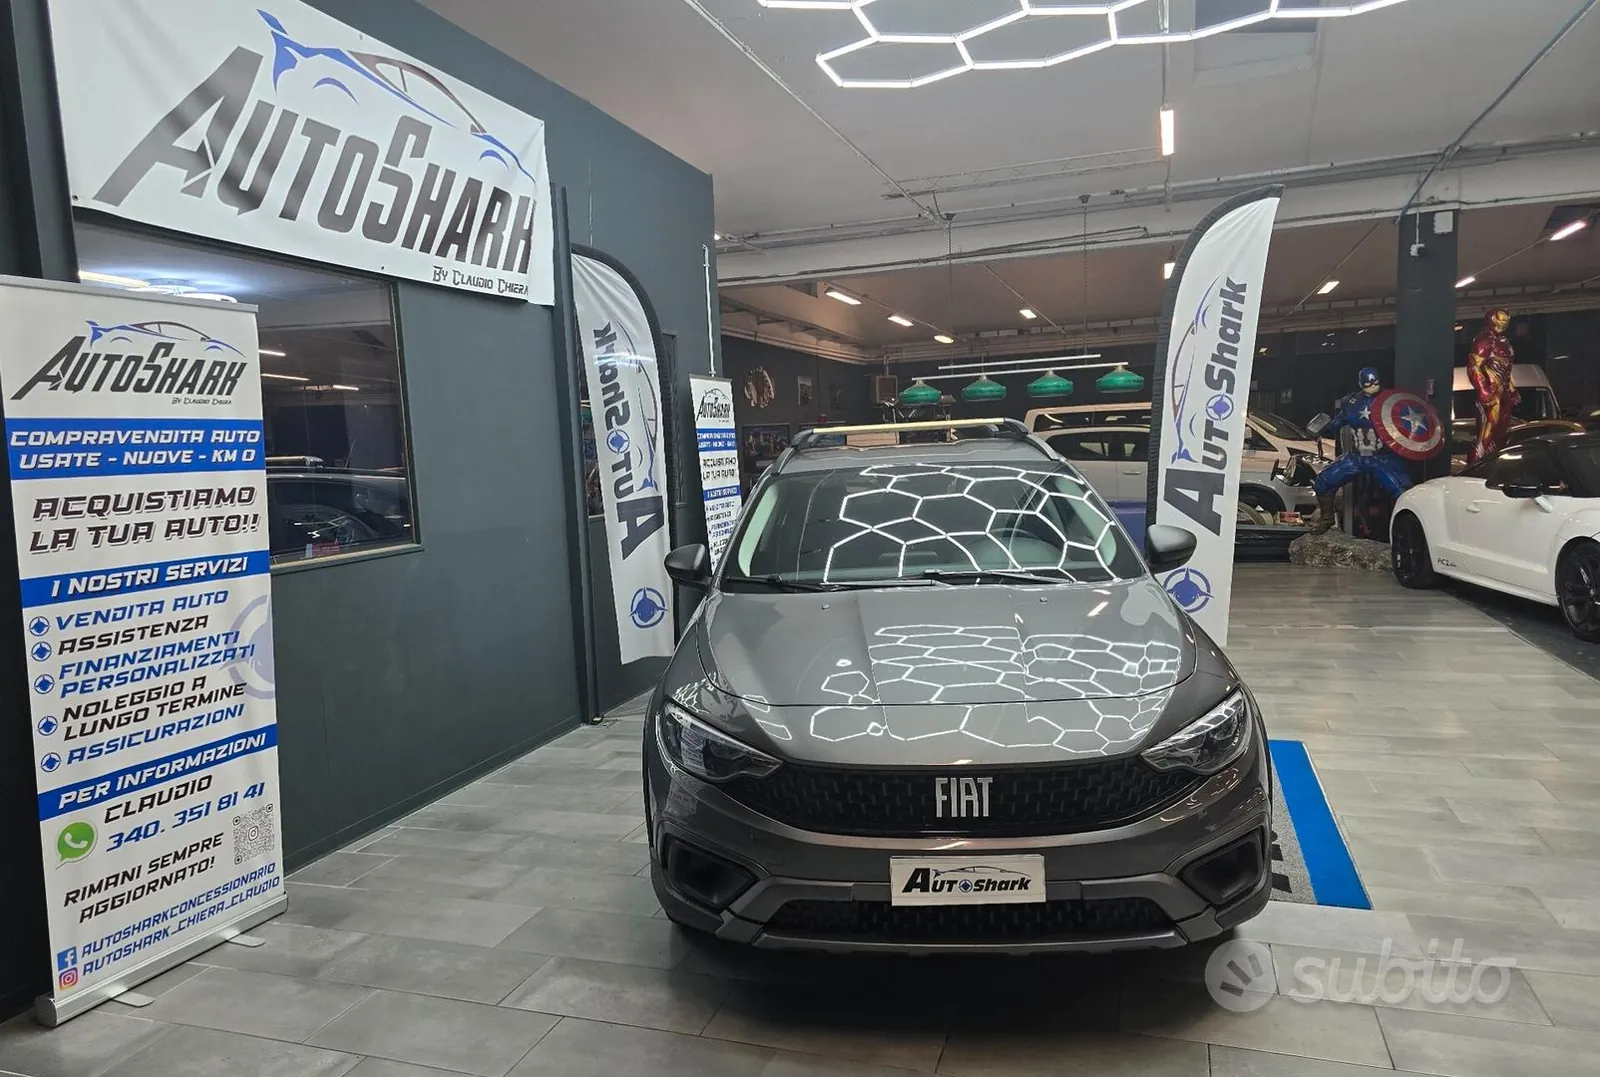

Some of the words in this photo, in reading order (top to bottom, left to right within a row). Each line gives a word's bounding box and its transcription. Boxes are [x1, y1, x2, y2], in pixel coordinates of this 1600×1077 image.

[10, 430, 204, 446] COMPRAVENDITA
[211, 430, 260, 444] AUTO
[19, 452, 102, 469] USATE
[123, 450, 194, 465] NUOVE
[212, 450, 236, 462] KM
[33, 486, 256, 519] ACQUISTIAMO
[30, 528, 77, 553] LA
[87, 521, 155, 547] TUA
[164, 513, 260, 538] AUTO!!
[51, 580, 60, 597] I
[68, 567, 158, 595] NOSTRI
[165, 557, 249, 581] SERVIZI
[56, 600, 164, 631] VENDITA
[172, 590, 229, 611] AUTO
[58, 615, 209, 655] ASSISTENZA
[59, 631, 241, 680] FINANZIAMENTI
[60, 644, 256, 699] PERSONALIZZATI
[62, 681, 184, 722] NOLEGGIO
[191, 675, 207, 691] A
[64, 708, 149, 742] LUNGO
[156, 682, 247, 718] TERMINE
[67, 704, 245, 765] ASSICURAZIONI
[58, 782, 111, 810] PER
[115, 732, 267, 790] INFORMAZIONI
[104, 774, 213, 824] CLAUDIO
[106, 820, 165, 852] 340.
[171, 801, 211, 829] 351
[216, 791, 238, 812] 81
[242, 781, 265, 799] 41
[935, 777, 993, 818] FIAT
[64, 865, 142, 907] RIMANI
[147, 833, 225, 875] SEMPRE
[79, 856, 216, 923] AGGIORNATO!
[81, 862, 276, 958] AUTOSHARKCONCESSIONARIO
